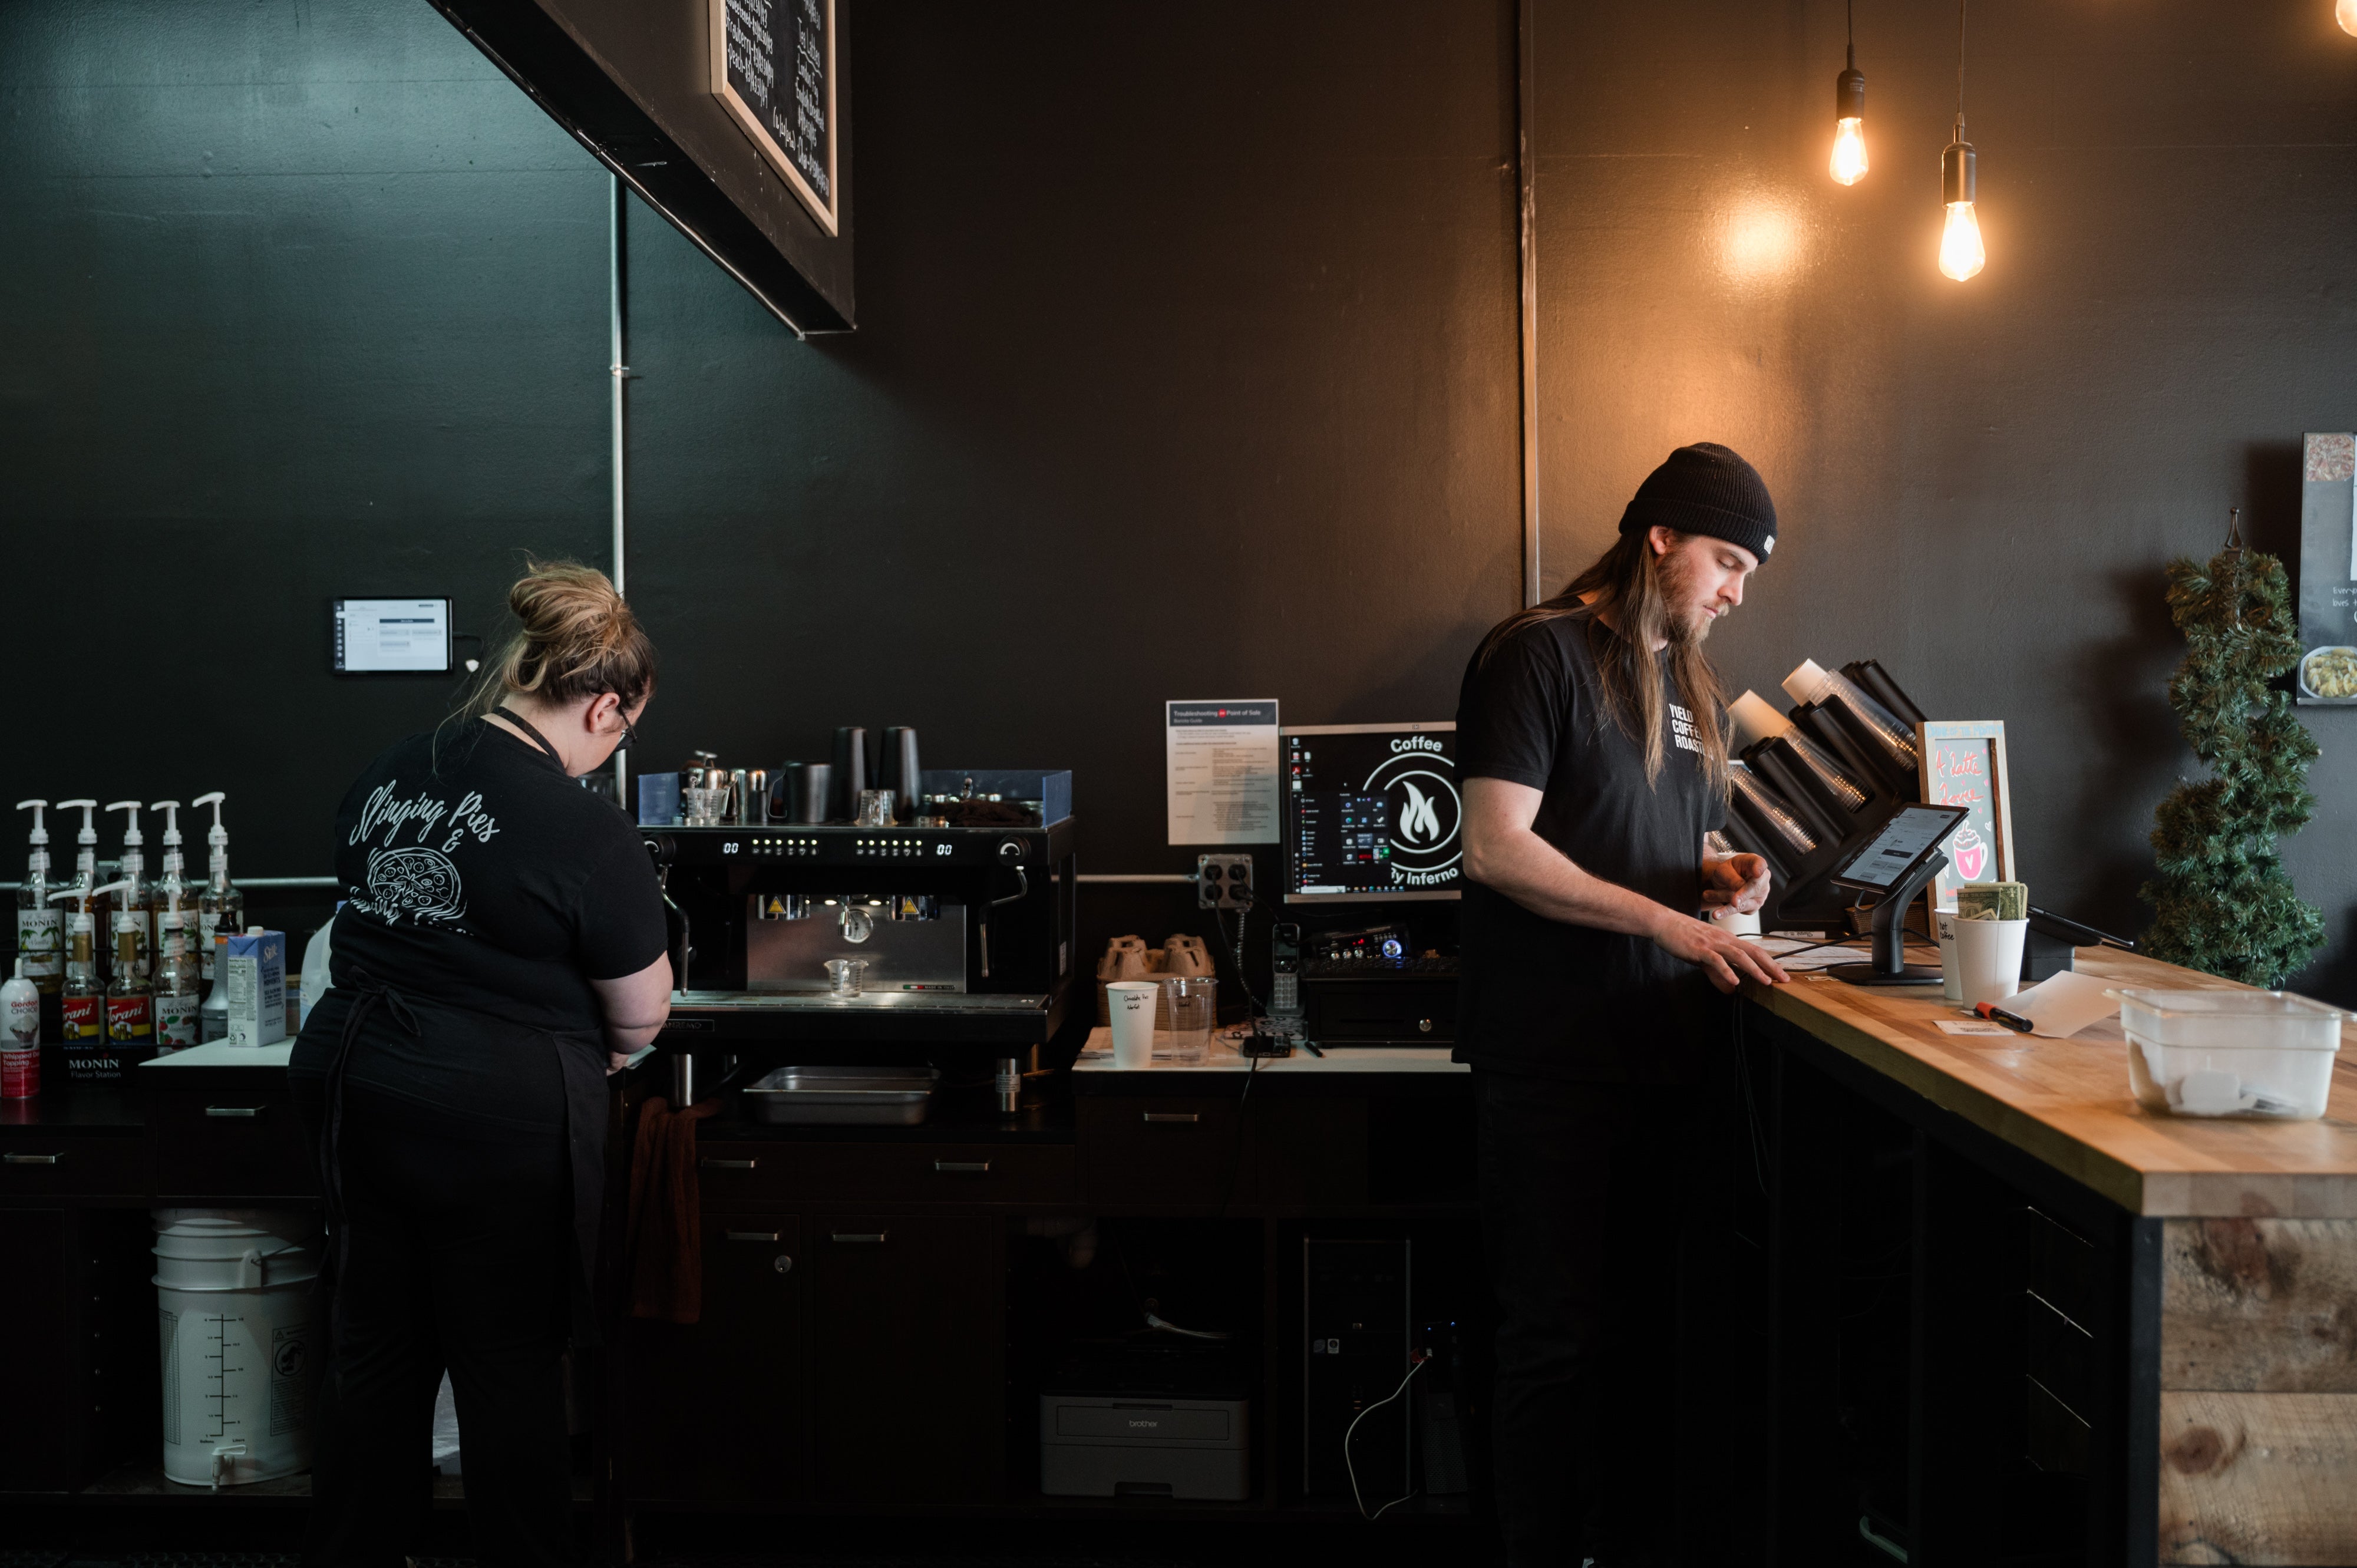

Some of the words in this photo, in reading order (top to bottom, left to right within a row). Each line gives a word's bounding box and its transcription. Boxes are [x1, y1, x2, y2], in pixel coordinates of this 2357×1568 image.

[1174, 709, 1217, 718] Troubleshooting
[1669, 703, 1694, 723] YIELD
[1672, 719, 1702, 740] COFFE
[1390, 735, 1443, 752] Coffee
[1950, 750, 1983, 777] Latte
[349, 779, 448, 847] Slinging
[448, 790, 500, 843] Pies
[722, 843, 739, 854] 00
[936, 844, 953, 856] 00
[1407, 867, 1460, 886] Inferno
[22, 919, 58, 927] MONIN
[1939, 921, 1948, 930] hot
[263, 943, 278, 963] Silk
[107, 1003, 143, 1022] Torani
[162, 1005, 197, 1014] MONIN
[3, 1051, 32, 1061] Whipped
[69, 1059, 120, 1069] MONIN
[71, 1070, 93, 1078] Flavor
[95, 1070, 121, 1079] Station
